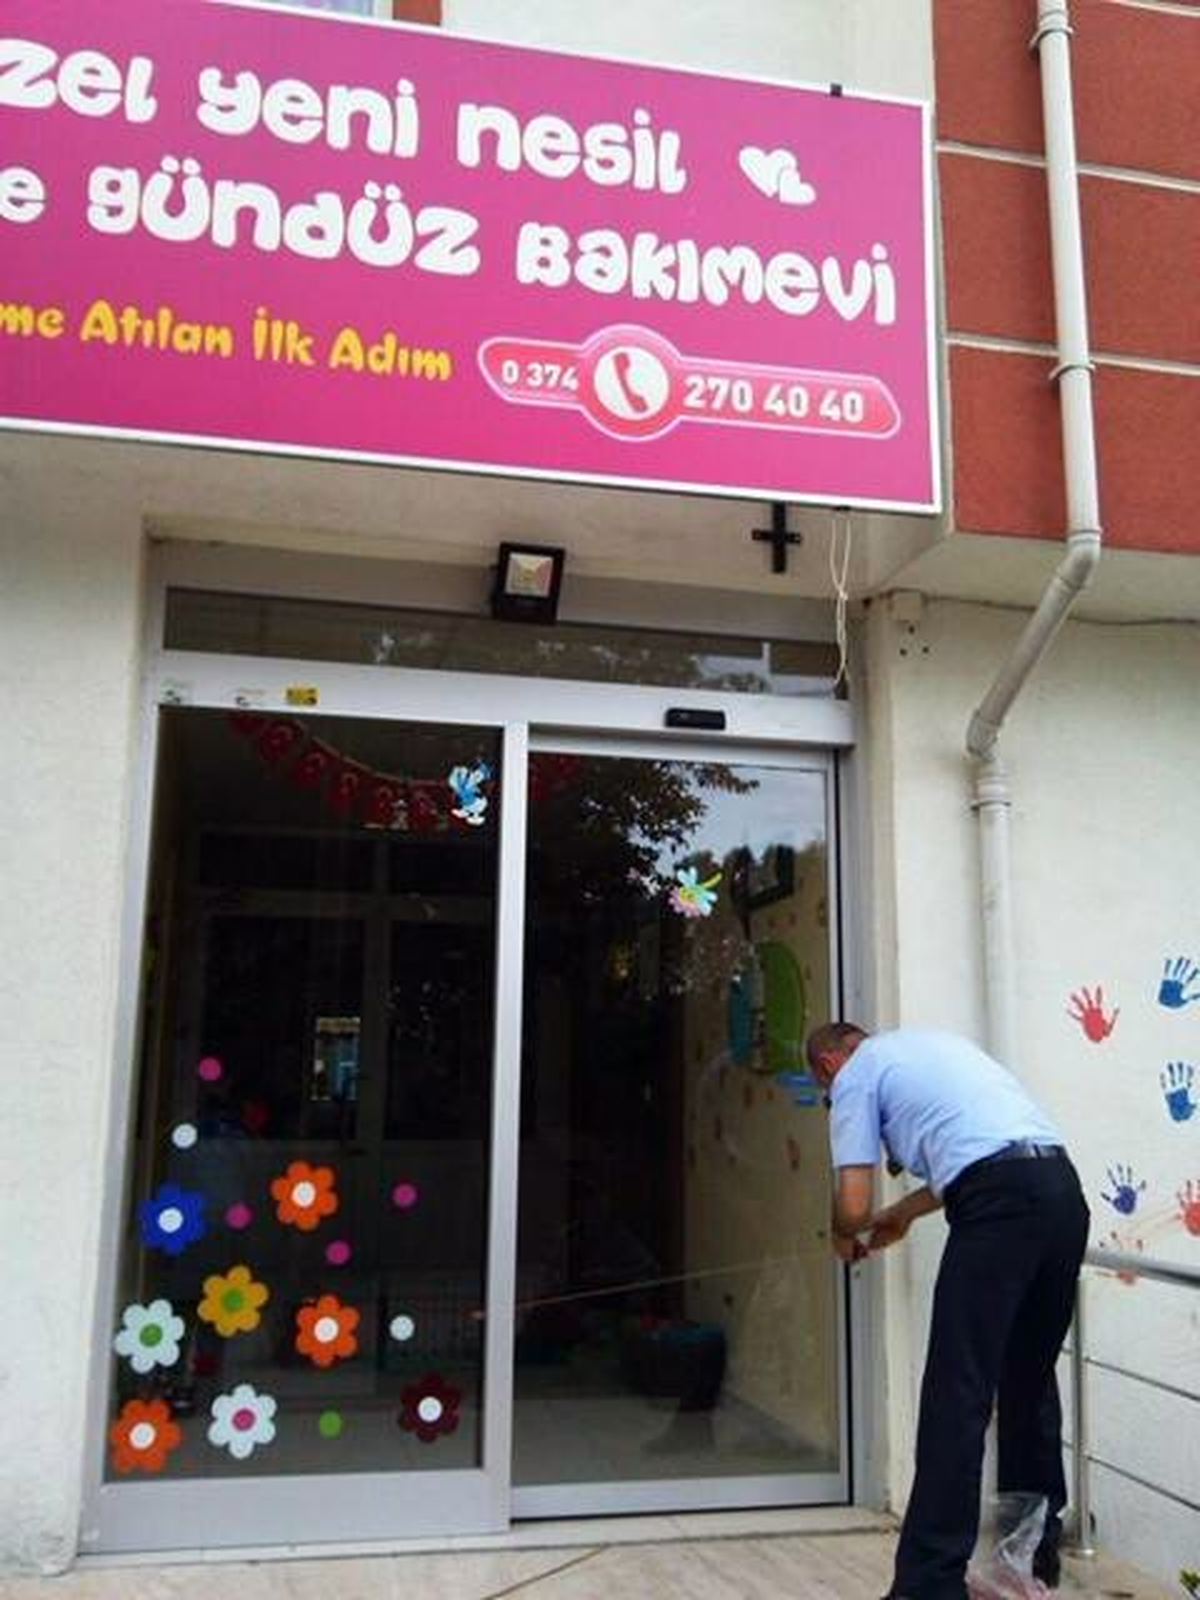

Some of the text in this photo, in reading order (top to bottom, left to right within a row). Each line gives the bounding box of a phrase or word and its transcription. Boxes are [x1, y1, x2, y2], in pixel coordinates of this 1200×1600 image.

[197, 67, 419, 158] yeni
[457, 103, 687, 193] nesil
[87, 155, 481, 276] gündüz
[80, 299, 233, 357] Atılan
[253, 307, 314, 366] İlk
[330, 327, 452, 381] Adım
[502, 359, 865, 423] 0 374 270 40 40
